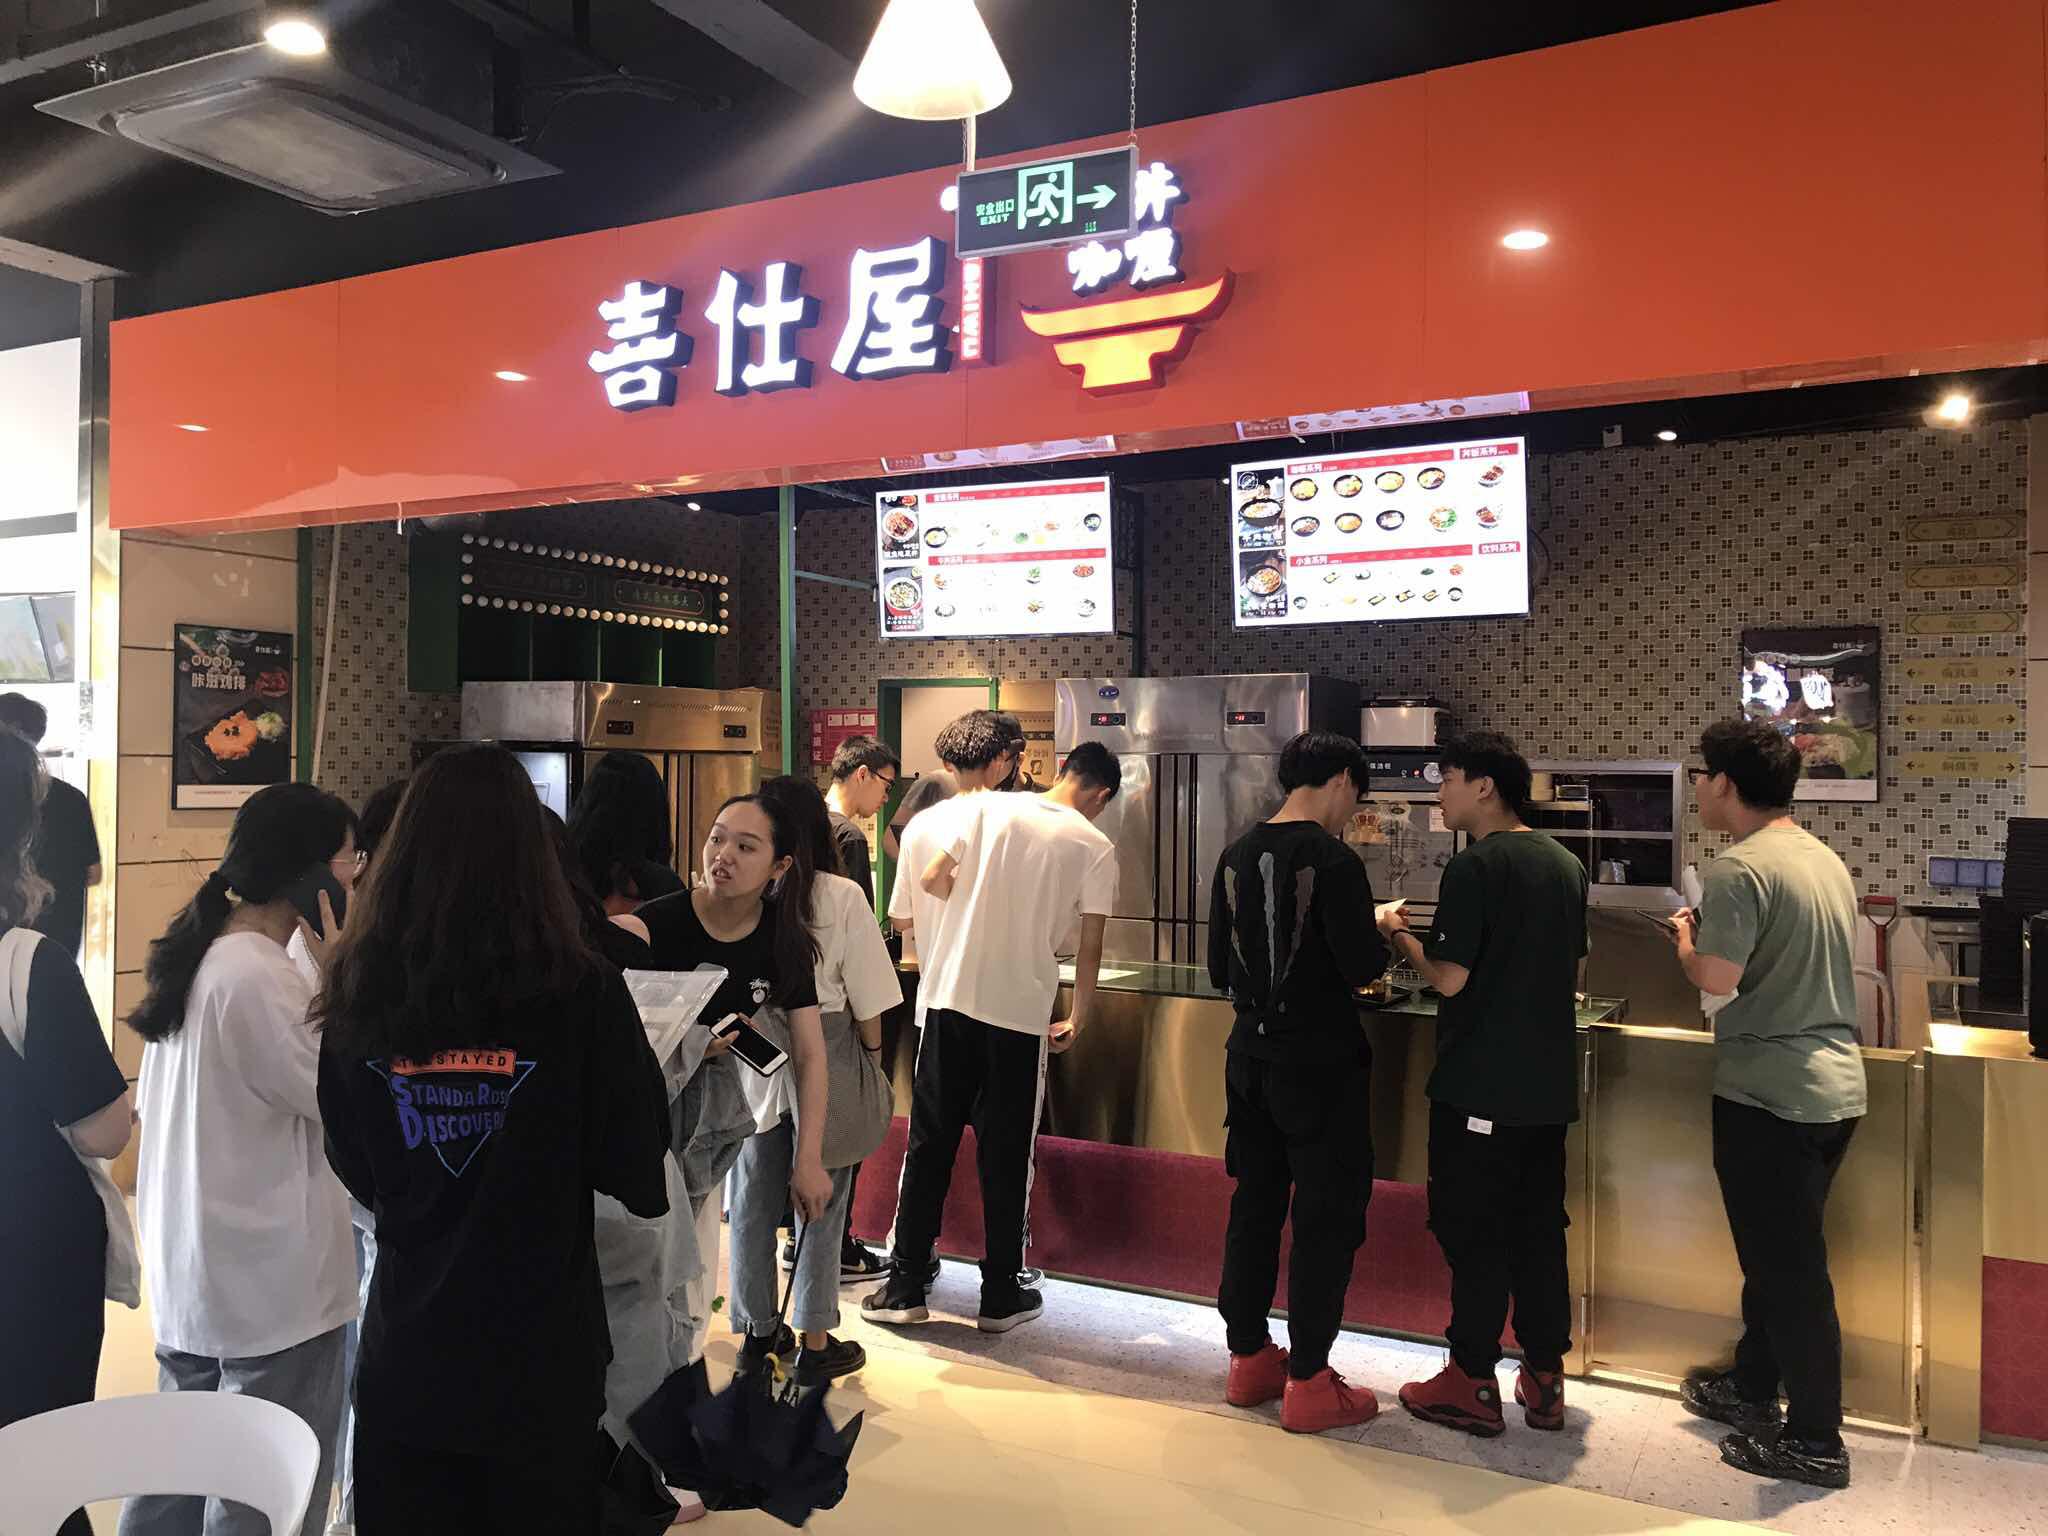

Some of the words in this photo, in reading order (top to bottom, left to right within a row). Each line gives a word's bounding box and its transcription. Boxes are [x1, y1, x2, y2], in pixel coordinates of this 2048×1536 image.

[976, 199, 1014, 216] 安全出口
[980, 213, 1009, 225] EXIT
[588, 237, 942, 408] 喜仕屋
[436, 1053, 507, 1067] STAYED
